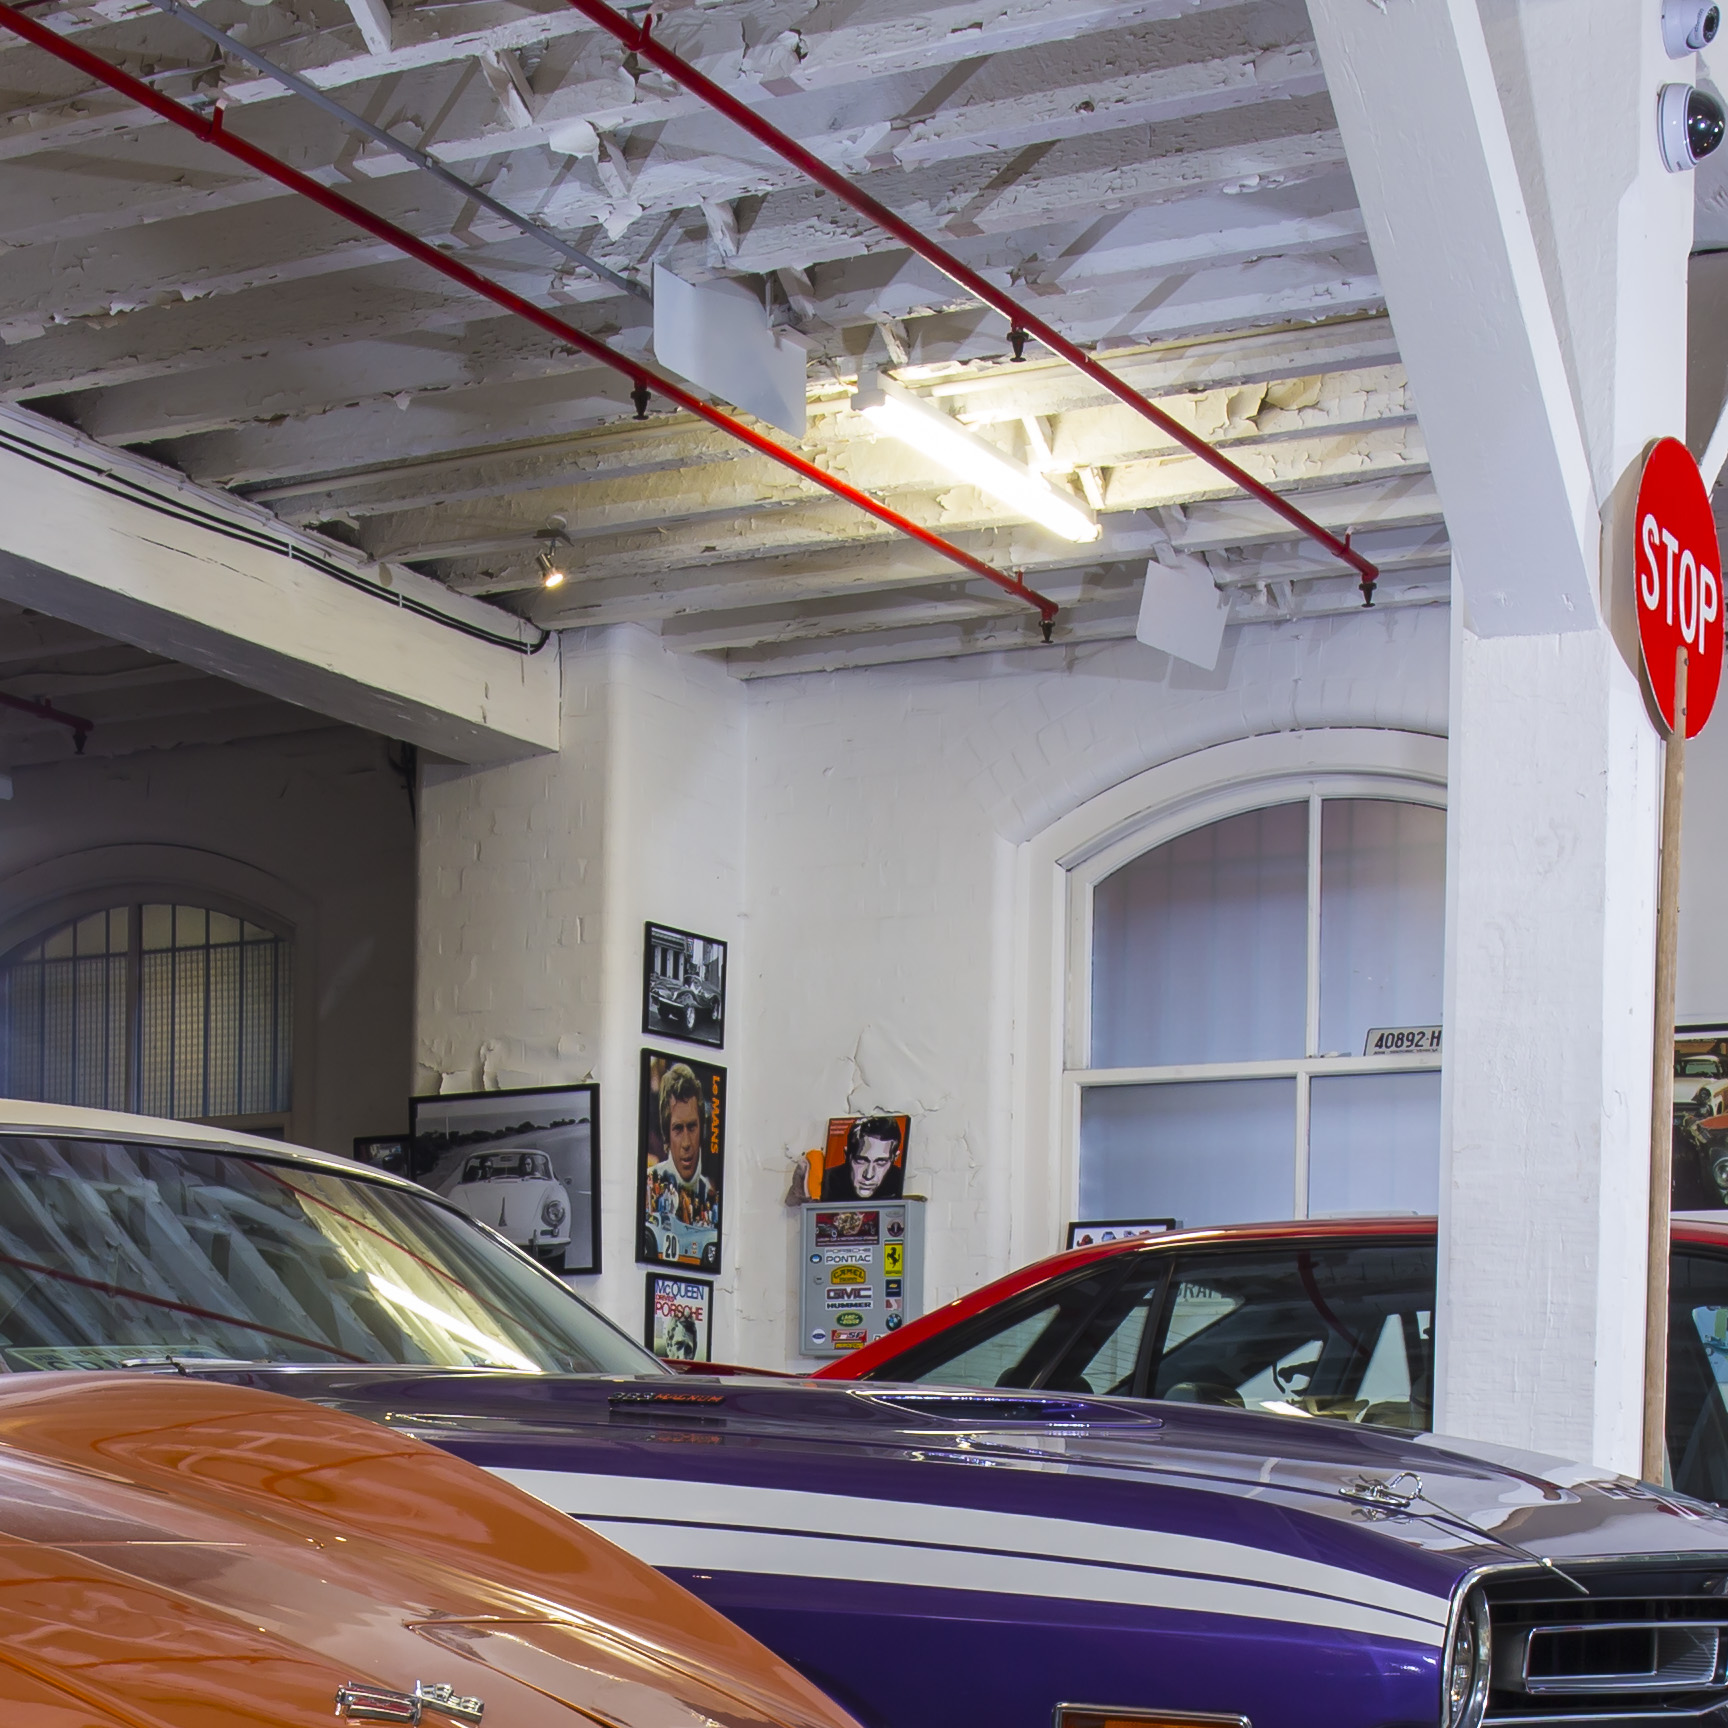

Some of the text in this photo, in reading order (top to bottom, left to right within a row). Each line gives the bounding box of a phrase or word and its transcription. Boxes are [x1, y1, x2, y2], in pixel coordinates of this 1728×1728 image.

[1640, 513, 1718, 655] STOP
[710, 1098, 721, 1154] MANS
[665, 1234, 678, 1259] 20
[825, 1254, 872, 1264] PONTIAC
[833, 1268, 864, 1280] CAMEL
[826, 1287, 872, 1300] GMC
[655, 1301, 704, 1322] PORSCHE
